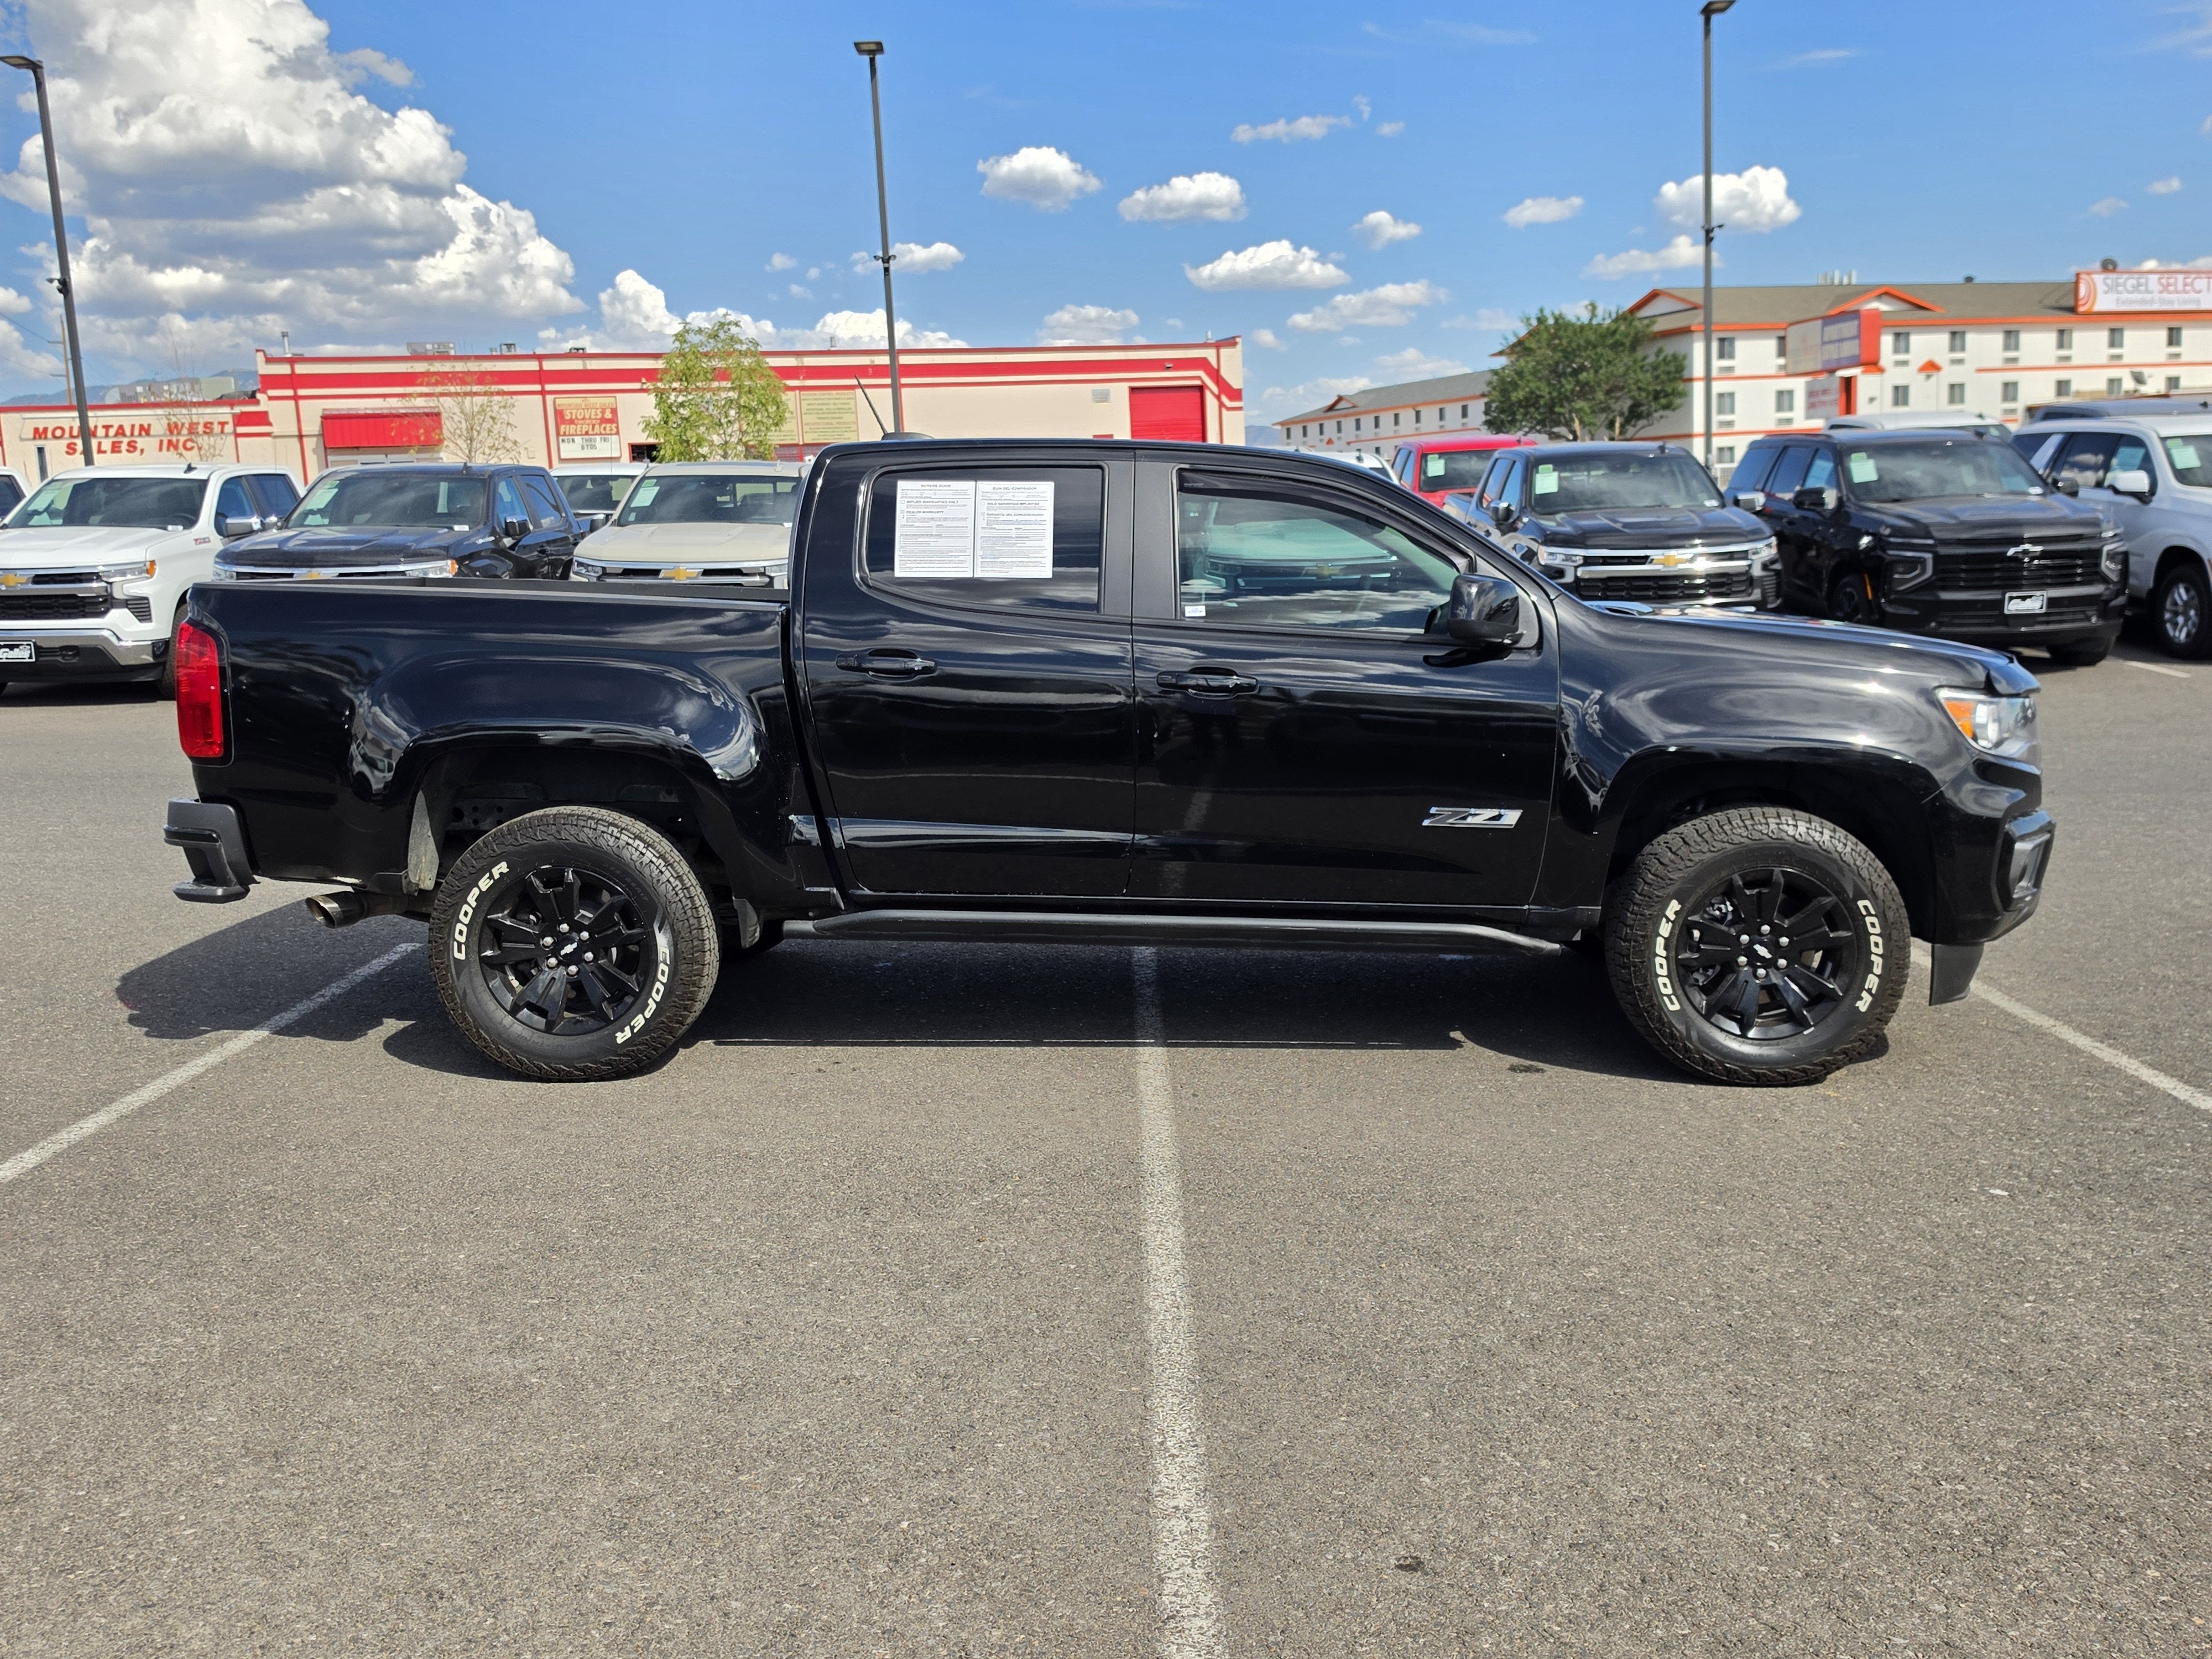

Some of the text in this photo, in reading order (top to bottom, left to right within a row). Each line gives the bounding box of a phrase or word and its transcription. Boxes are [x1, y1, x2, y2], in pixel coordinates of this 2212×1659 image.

[2102, 275, 2212, 294] SIEGEL SELECT
[565, 408, 612, 420] STOVES &
[32, 421, 229, 439] MOUNTAIN WEST
[560, 424, 617, 435] FIREPLACES
[65, 438, 202, 456] SLES, INC.
[1422, 806, 1523, 828] Z71
[453, 861, 510, 961] COOPER
[1655, 899, 1682, 1011] COOPER
[1855, 899, 1884, 1013] COOPER
[615, 946, 670, 1044] COOPER
